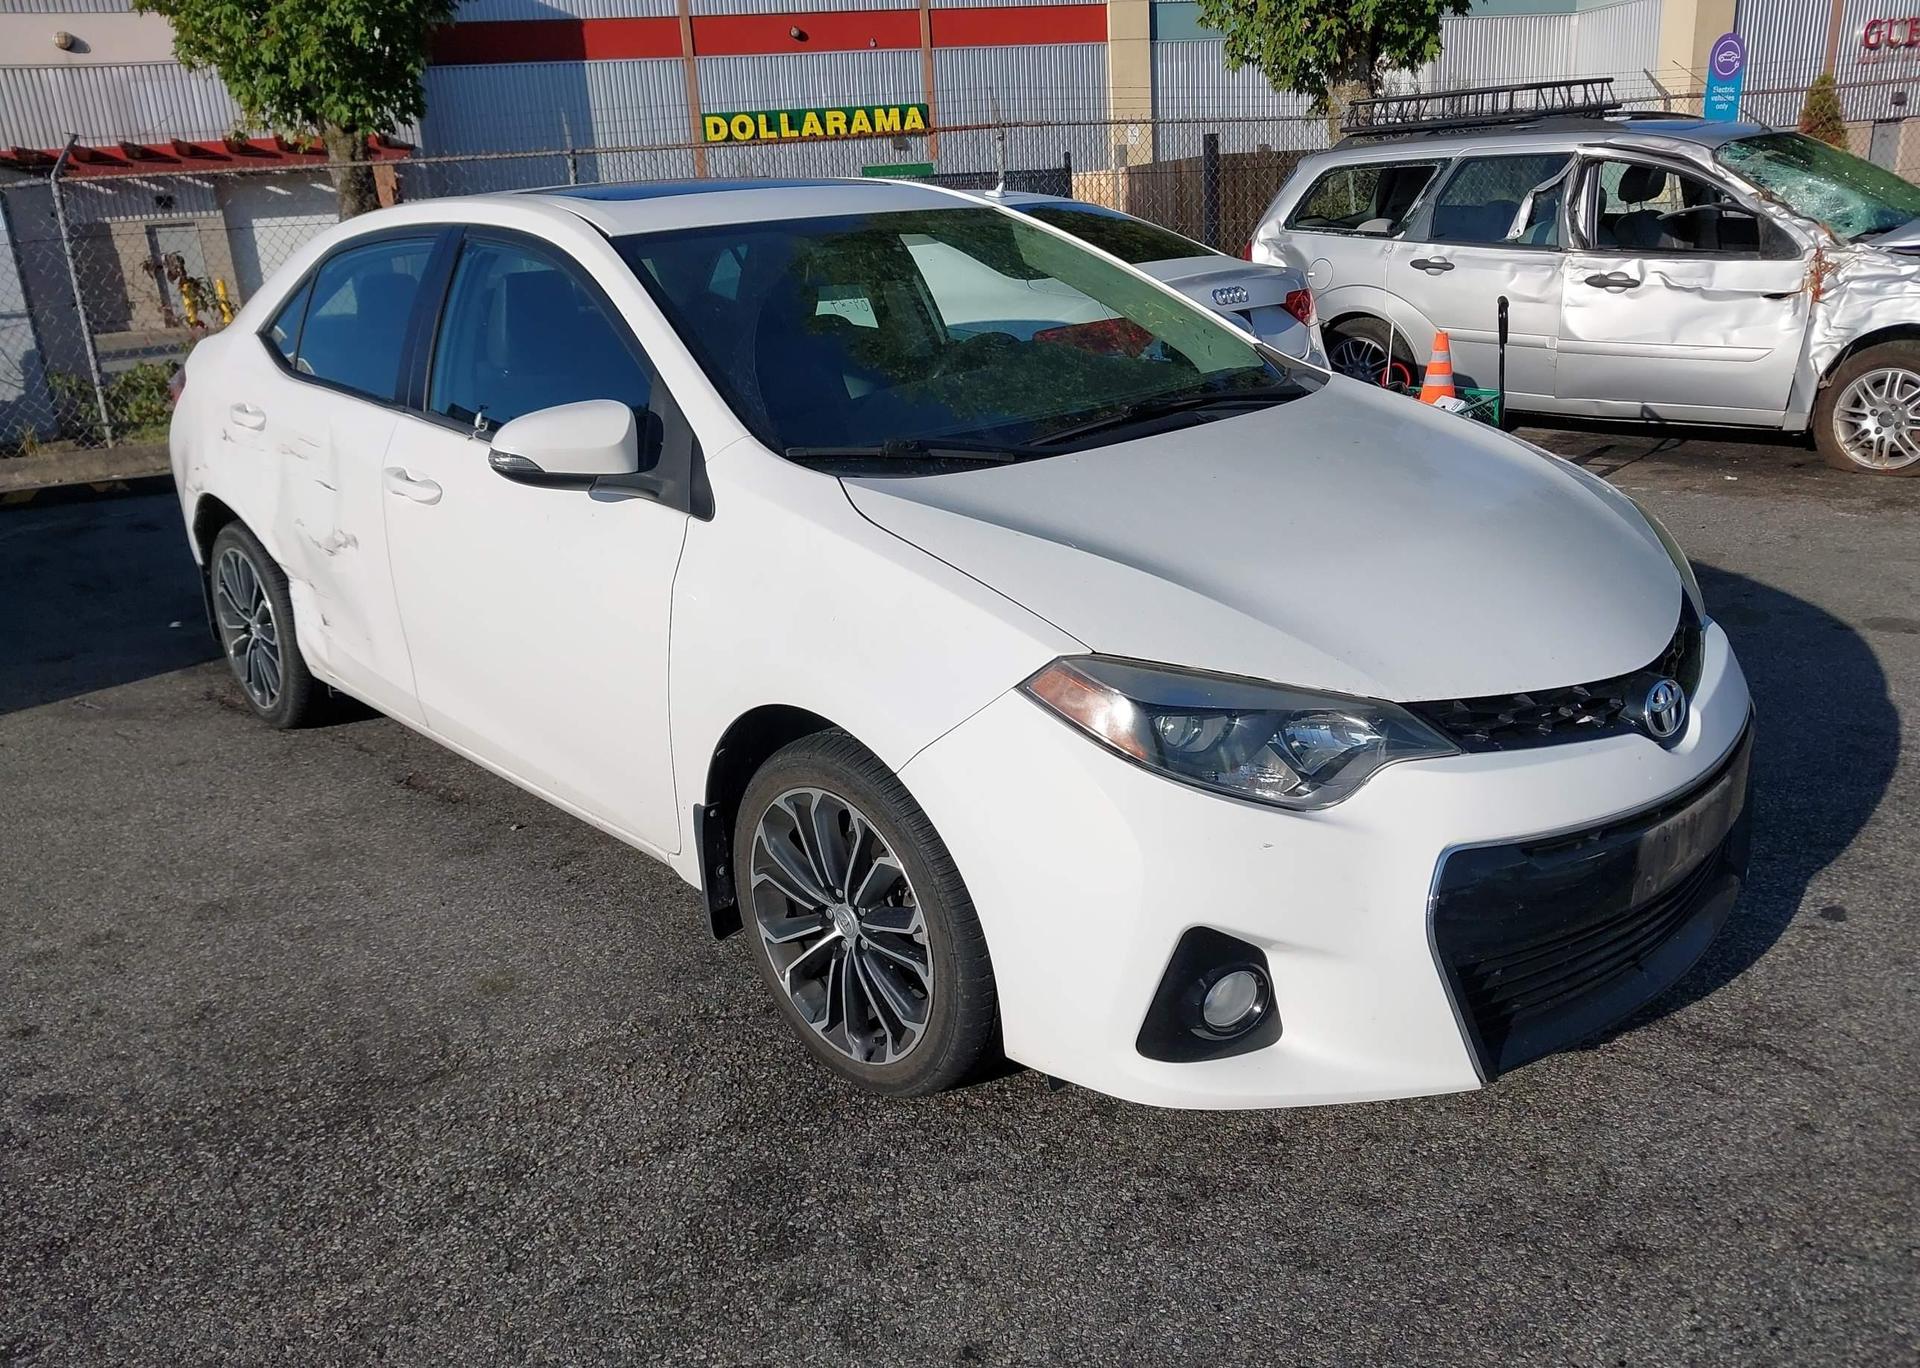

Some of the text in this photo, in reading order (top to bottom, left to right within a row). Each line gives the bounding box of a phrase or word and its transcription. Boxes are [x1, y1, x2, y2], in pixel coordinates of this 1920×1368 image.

[1712, 85, 1735, 93] Electric
[1715, 102, 1728, 111] only
[705, 106, 925, 142] DOLLARAMA
